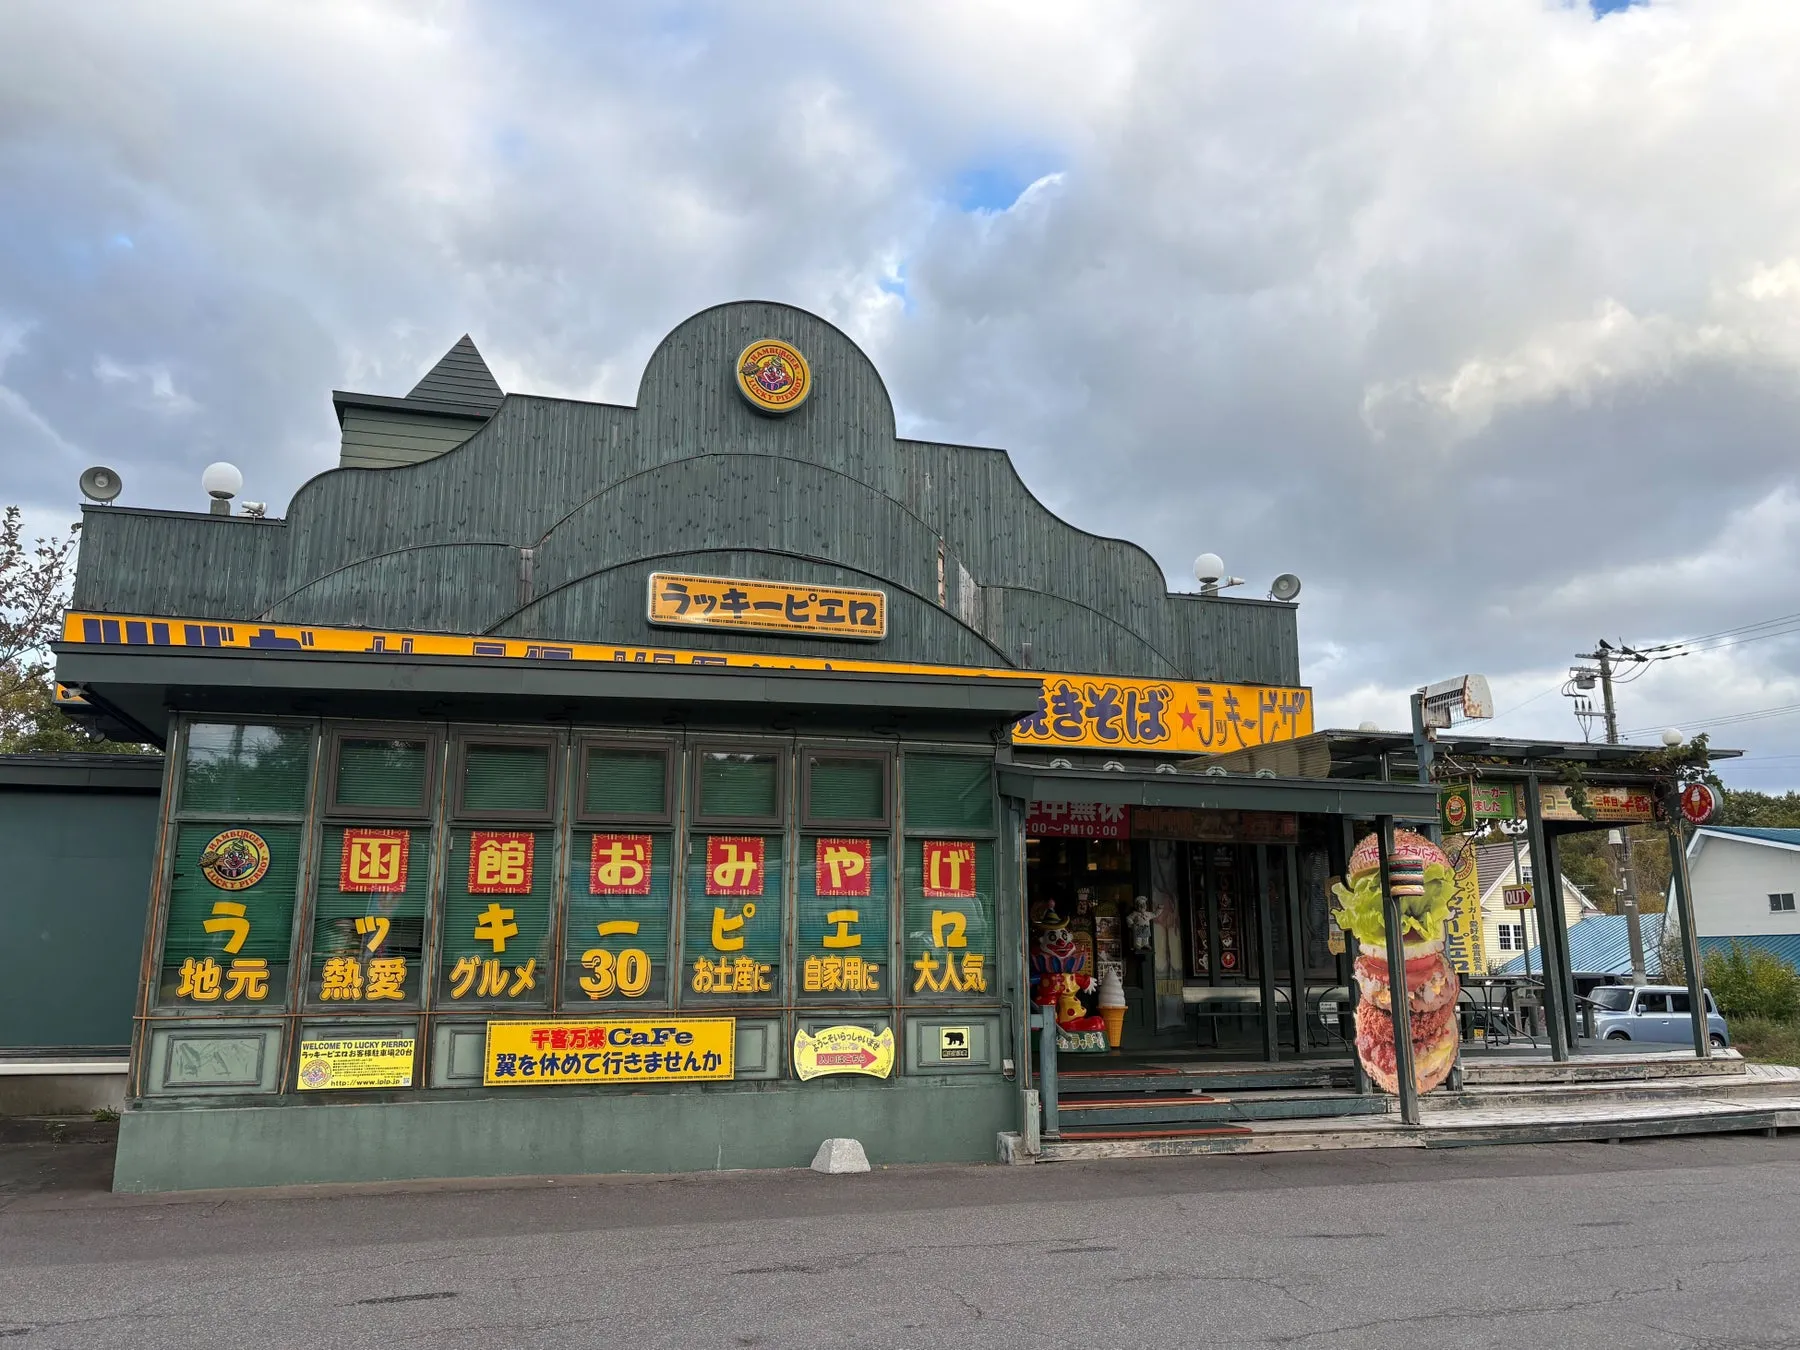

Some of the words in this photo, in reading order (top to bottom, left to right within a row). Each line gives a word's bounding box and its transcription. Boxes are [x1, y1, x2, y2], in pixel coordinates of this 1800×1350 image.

[750, 347, 800, 370] HAMBURGER
[748, 379, 774, 401] LUCKY
[776, 377, 802, 401] PIERROT
[660, 582, 877, 627] ラッキーピエロ
[1543, 794, 1594, 811] コーー
[208, 830, 265, 850] HAMBURGER
[1360, 848, 1380, 861] THE
[207, 870, 235, 888] LUCKY
[239, 856, 268, 888] PIERROT
[1505, 890, 1526, 904] OUT
[176, 957, 270, 1001] 地元
[320, 956, 407, 1001] 熱愛
[449, 955, 537, 999] グルメ
[579, 948, 652, 1000] 30
[692, 955, 772, 993] お土産に
[803, 954, 880, 993] 自家用に
[913, 952, 987, 993] 大人気
[303, 1042, 340, 1050] WELCOME
[354, 1041, 380, 1049] LUCKY
[381, 1040, 413, 1048] PIERROT
[531, 1026, 606, 1051] 千客万来
[812, 1032, 881, 1052] ようこそいらっしゃいませ
[494, 1049, 722, 1077] 翼を休めて行きませんか
[818, 1054, 867, 1065] 入口はこちら
